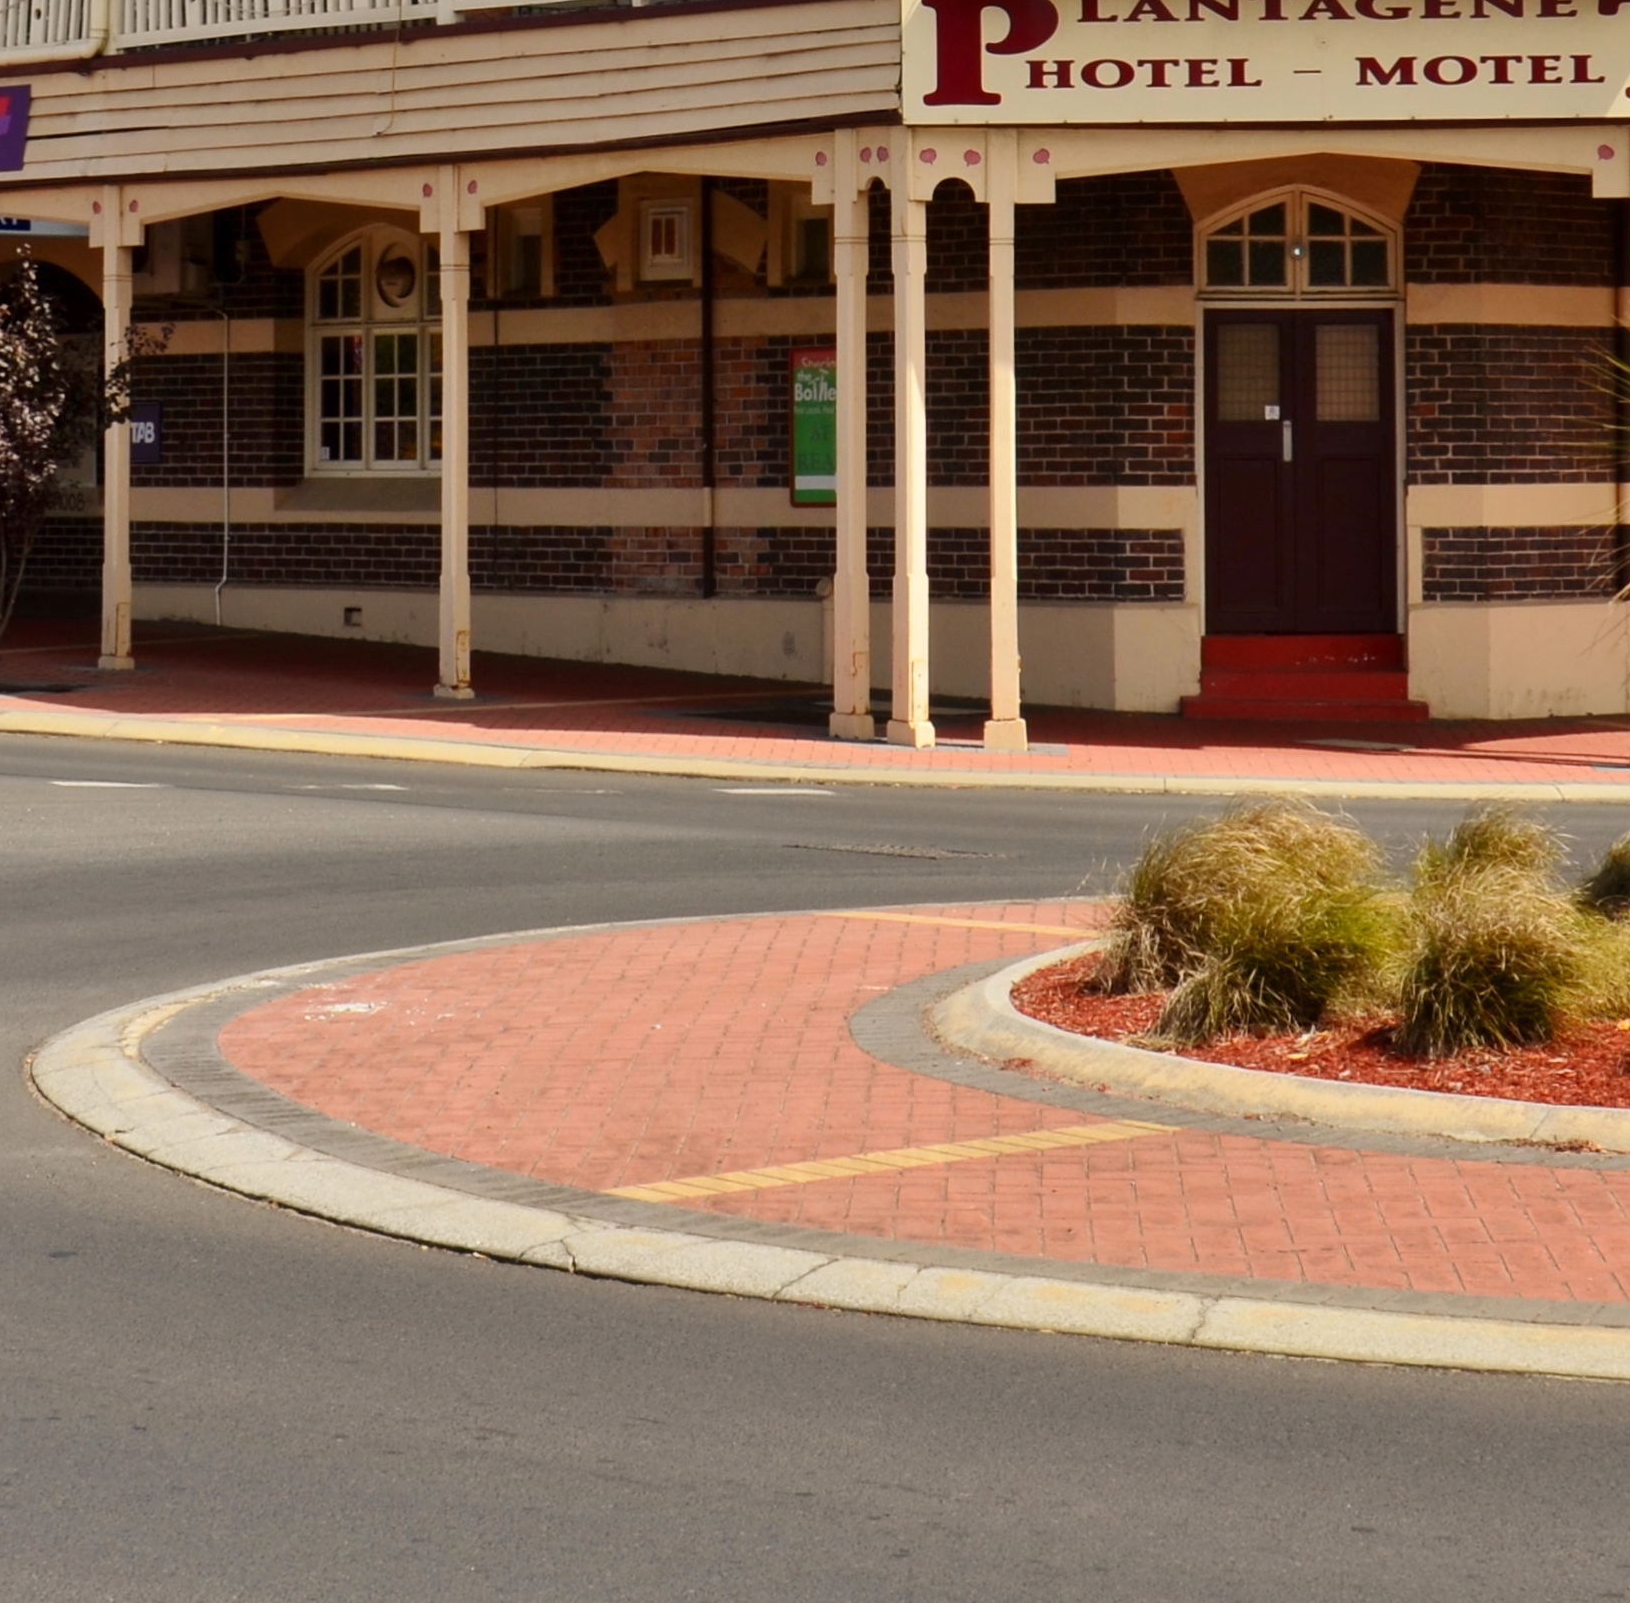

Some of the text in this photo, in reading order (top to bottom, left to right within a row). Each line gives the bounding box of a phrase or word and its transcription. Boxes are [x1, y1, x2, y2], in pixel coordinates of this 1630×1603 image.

[1025, 58, 1263, 90] HOTEL
[1354, 54, 1606, 88] MOTEL
[130, 422, 155, 444] TAB
